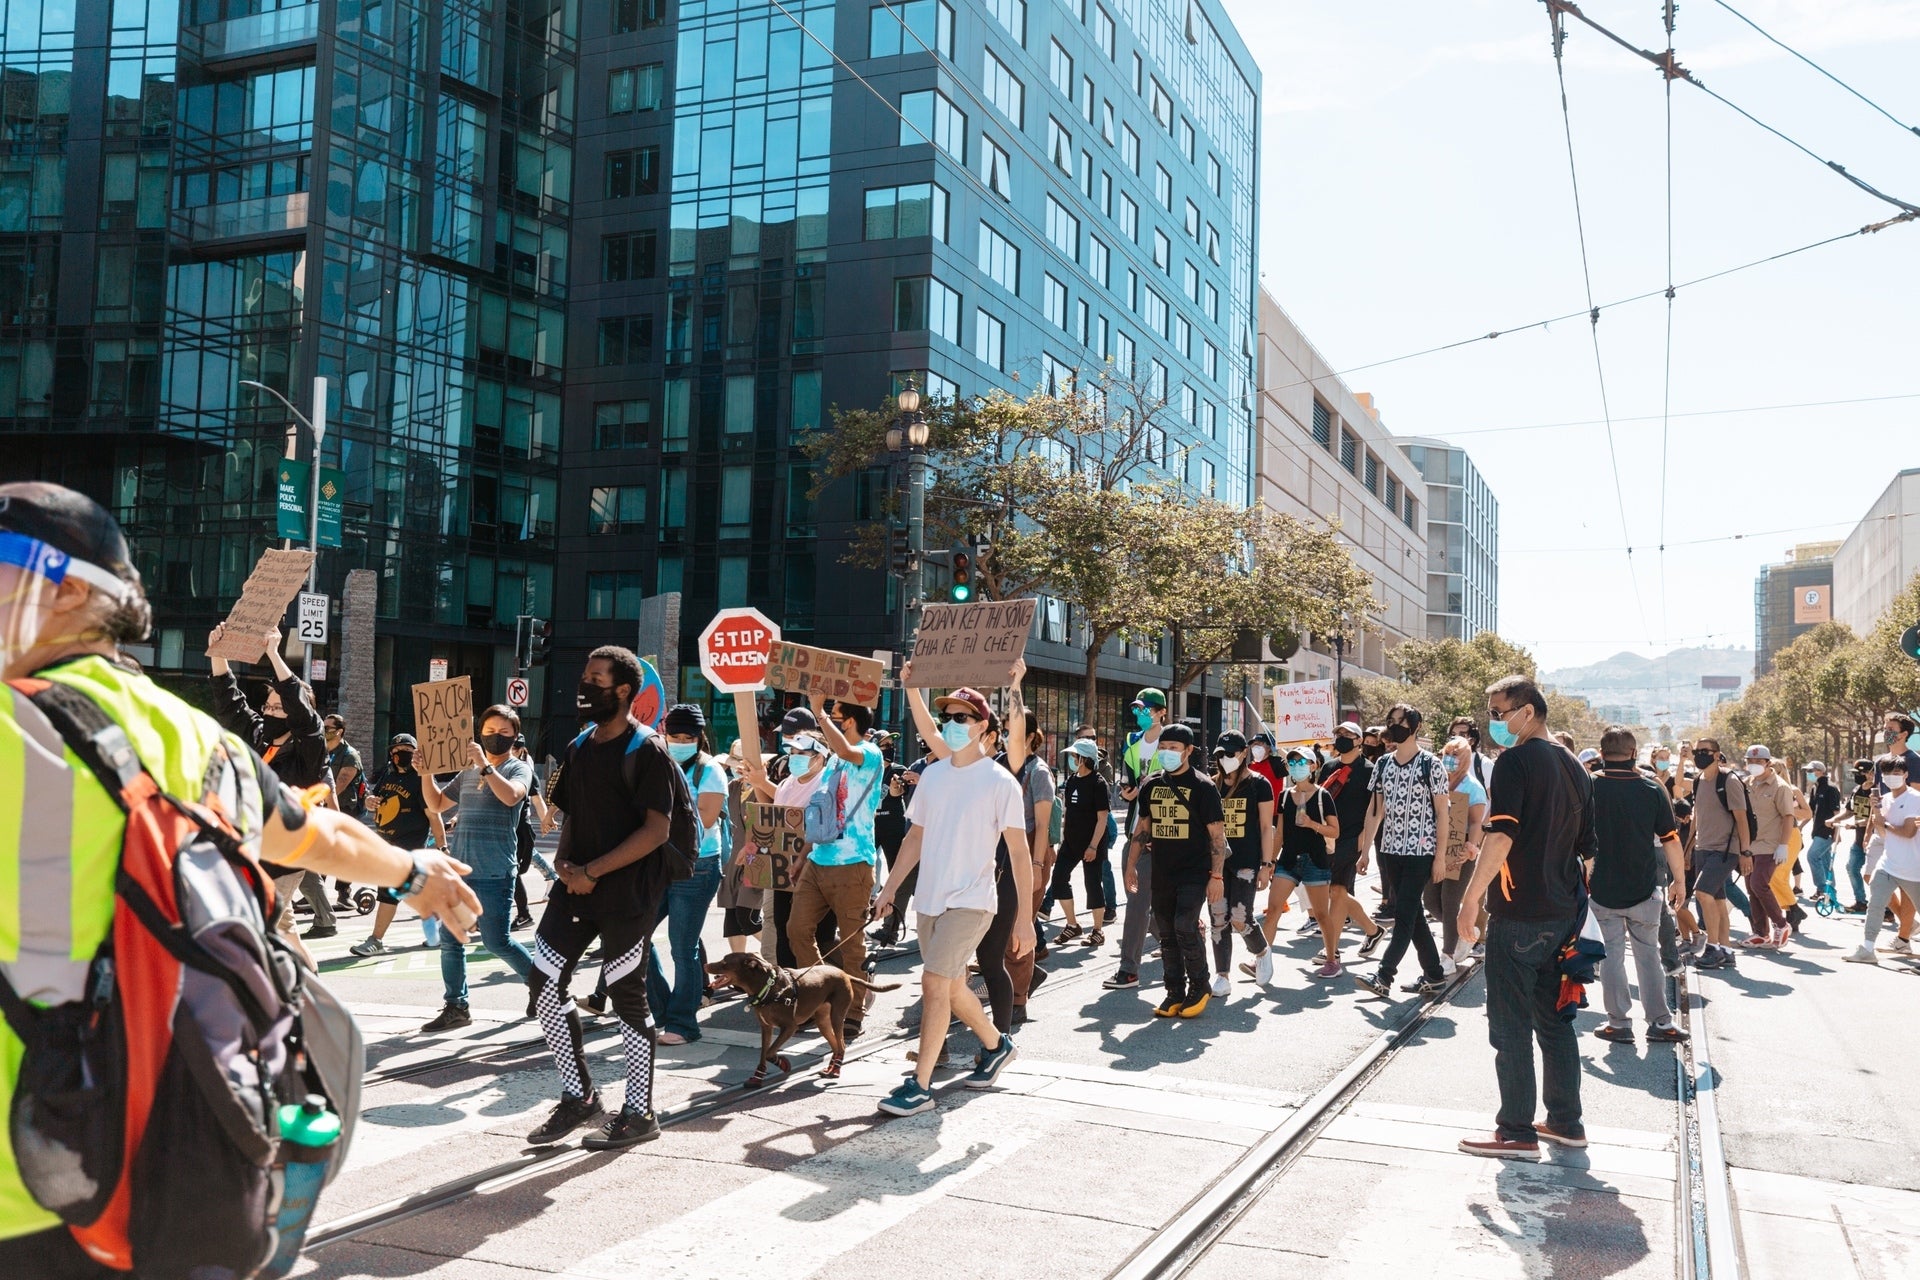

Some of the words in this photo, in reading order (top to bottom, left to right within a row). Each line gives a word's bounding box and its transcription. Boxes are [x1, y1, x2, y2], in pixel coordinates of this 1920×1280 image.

[280, 484, 295, 493] MAKE
[280, 493, 296, 503] POLICY
[302, 597, 326, 607] SPEED
[303, 608, 323, 618] LIMIT
[921, 606, 958, 631] ĐOÀN
[985, 605, 1005, 629] THÌ
[1001, 601, 1034, 629] SỐNG
[301, 620, 324, 638] 25
[714, 629, 764, 648] STOP
[915, 638, 938, 657] CHIA
[961, 632, 979, 655] THÌ
[983, 629, 1019, 653] CHẾT
[769, 643, 809, 668] END
[814, 652, 861, 678] HATE
[771, 664, 850, 697] SPREAD
[419, 683, 472, 726] RACISM
[427, 725, 437, 742] IS
[446, 721, 455, 739] A
[1159, 806, 1167, 818] TO
[1169, 806, 1178, 818] BE
[1230, 814, 1238, 823] BE
[1156, 826, 1179, 837] ASIAN
